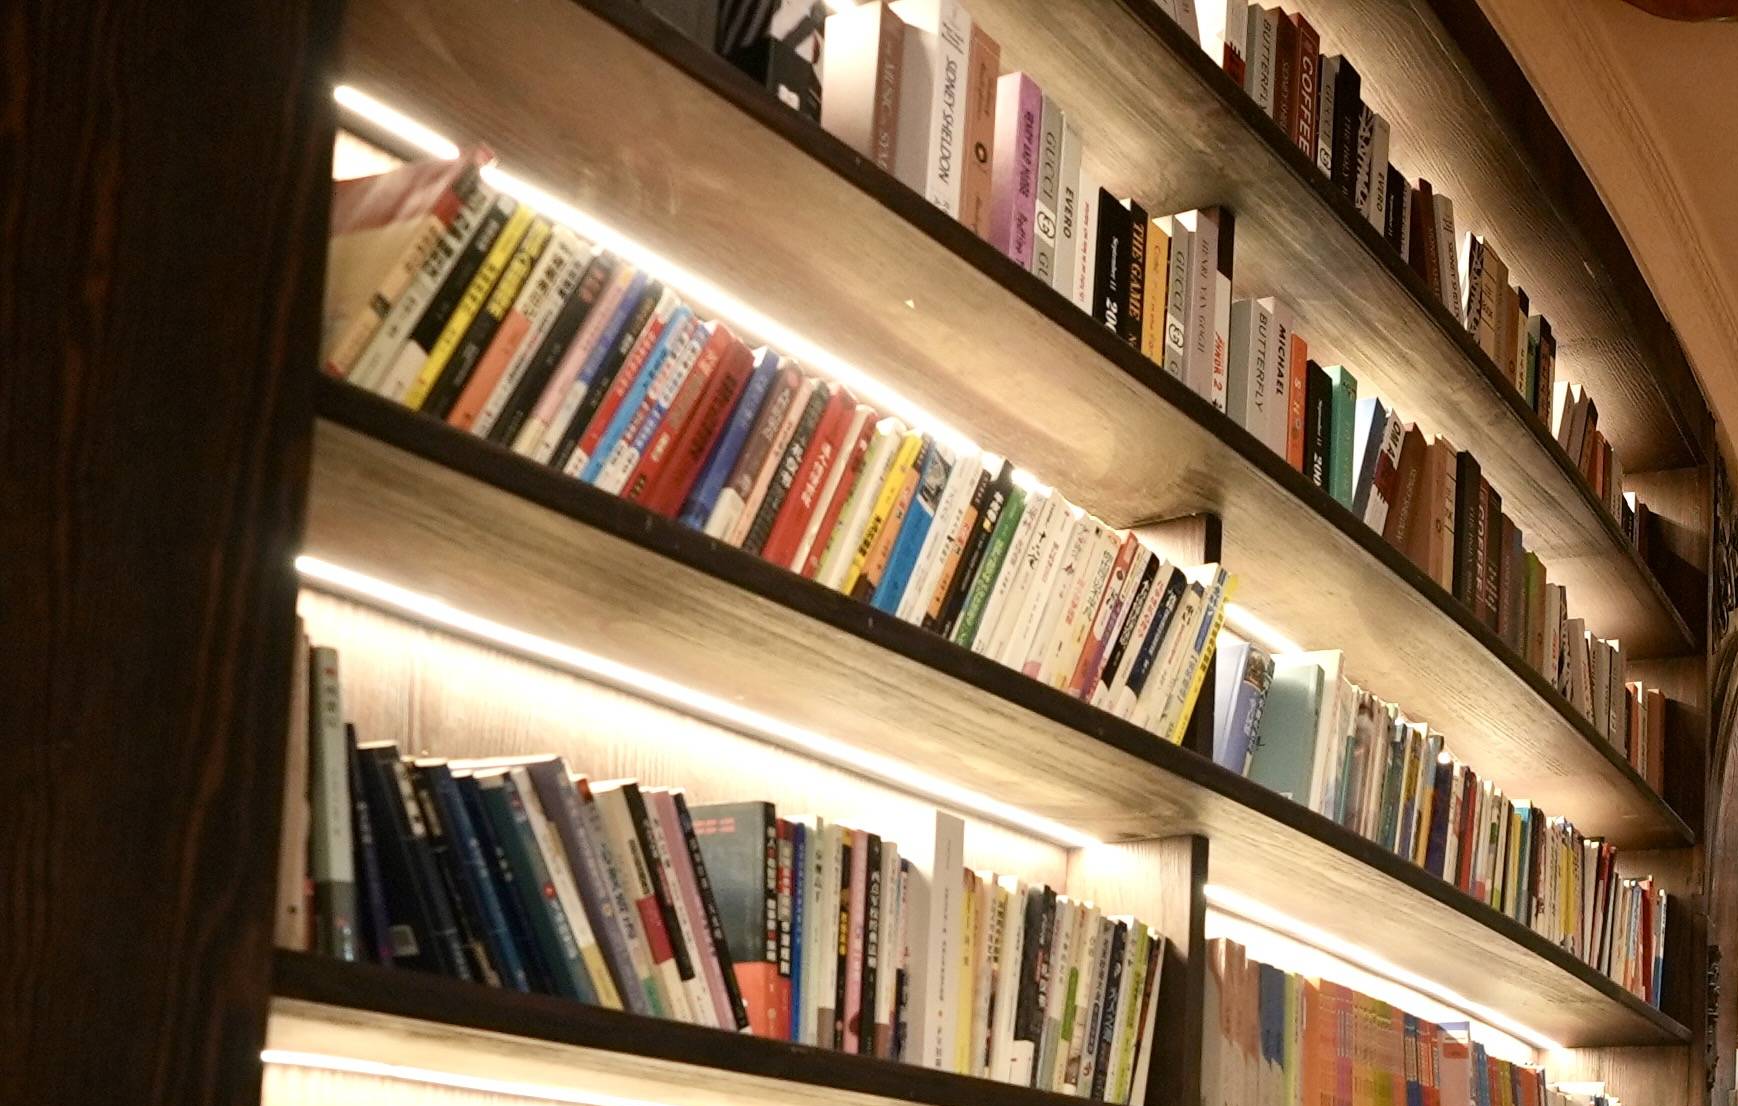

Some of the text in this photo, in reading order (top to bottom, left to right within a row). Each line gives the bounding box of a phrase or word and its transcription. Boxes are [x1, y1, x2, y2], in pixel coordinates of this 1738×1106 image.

[938, 60, 959, 185] SIDNEY SHELDON
[1299, 55, 1314, 158] COFFEE
[1042, 131, 1056, 200] GUCCI
[1062, 186, 1075, 240] EVERO
[1131, 223, 1146, 262] THE
[1128, 262, 1145, 323] GAME
[1172, 249, 1186, 314] GUCCI
[1254, 311, 1269, 414] BUTTERFLY
[1275, 323, 1287, 397] MICHAEL
